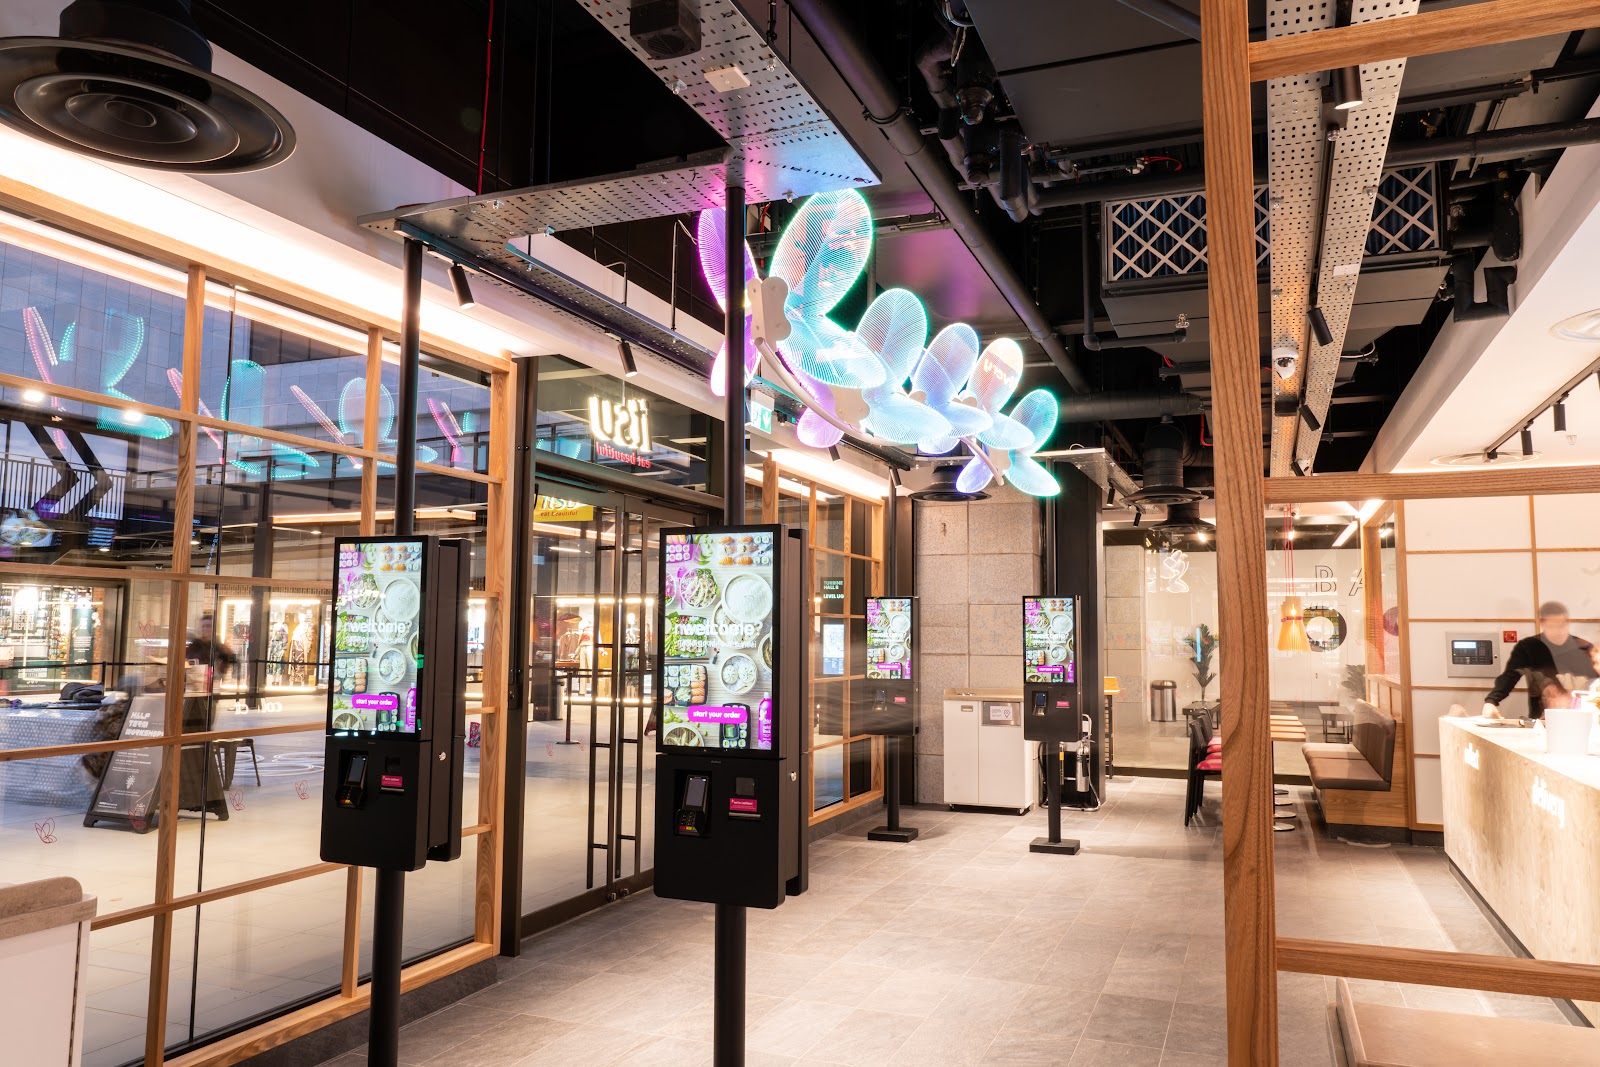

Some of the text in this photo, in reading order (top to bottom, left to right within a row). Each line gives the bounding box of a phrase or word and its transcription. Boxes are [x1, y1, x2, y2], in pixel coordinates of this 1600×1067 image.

[692, 710, 741, 719] start your order
